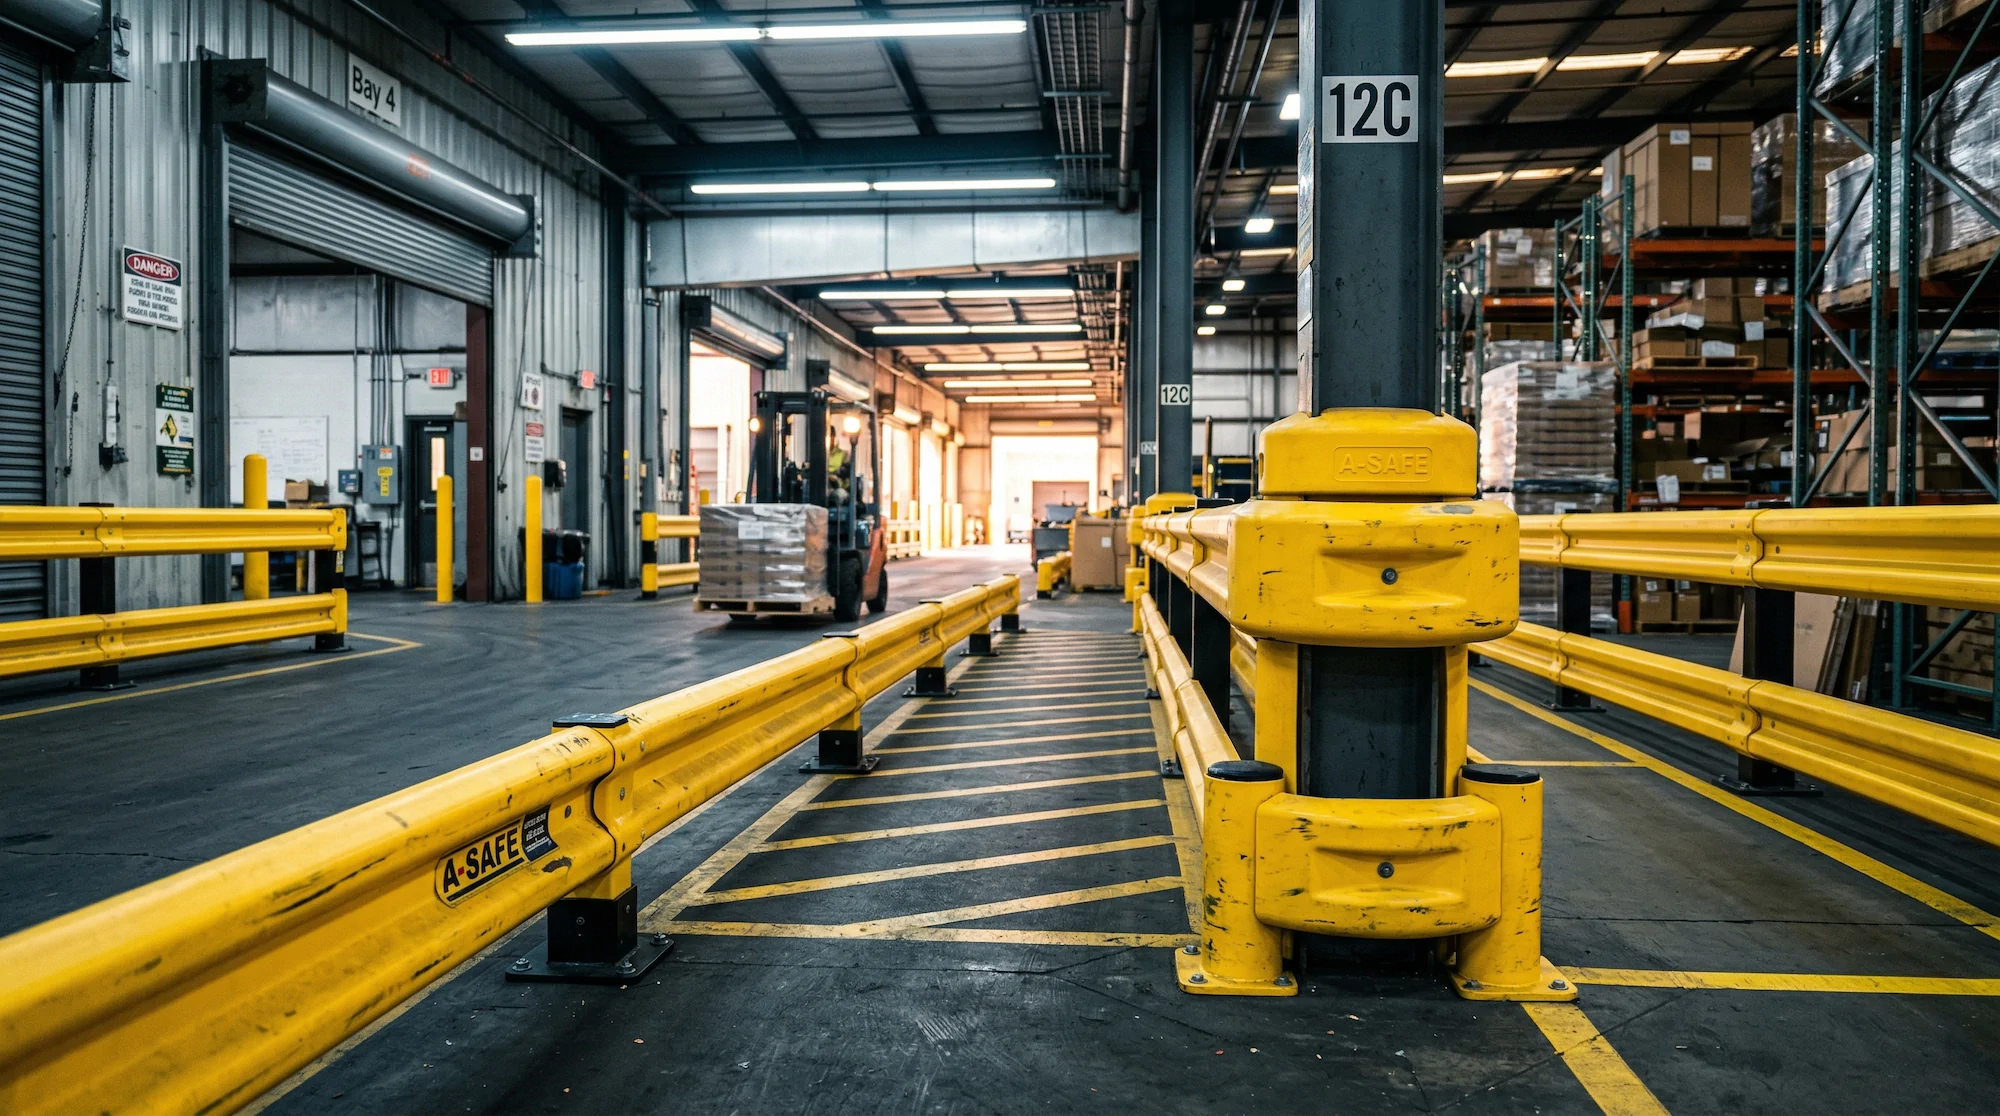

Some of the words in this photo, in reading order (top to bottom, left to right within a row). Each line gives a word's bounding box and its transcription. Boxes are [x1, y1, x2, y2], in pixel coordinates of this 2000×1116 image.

[353, 65, 382, 110] Bay
[386, 86, 396, 113] 4
[1330, 82, 1411, 137] 12C
[133, 256, 173, 278] DANGER
[1162, 386, 1189, 404] 12C
[1339, 453, 1429, 475] A-SAFE
[443, 826, 521, 894] A-SAFE
